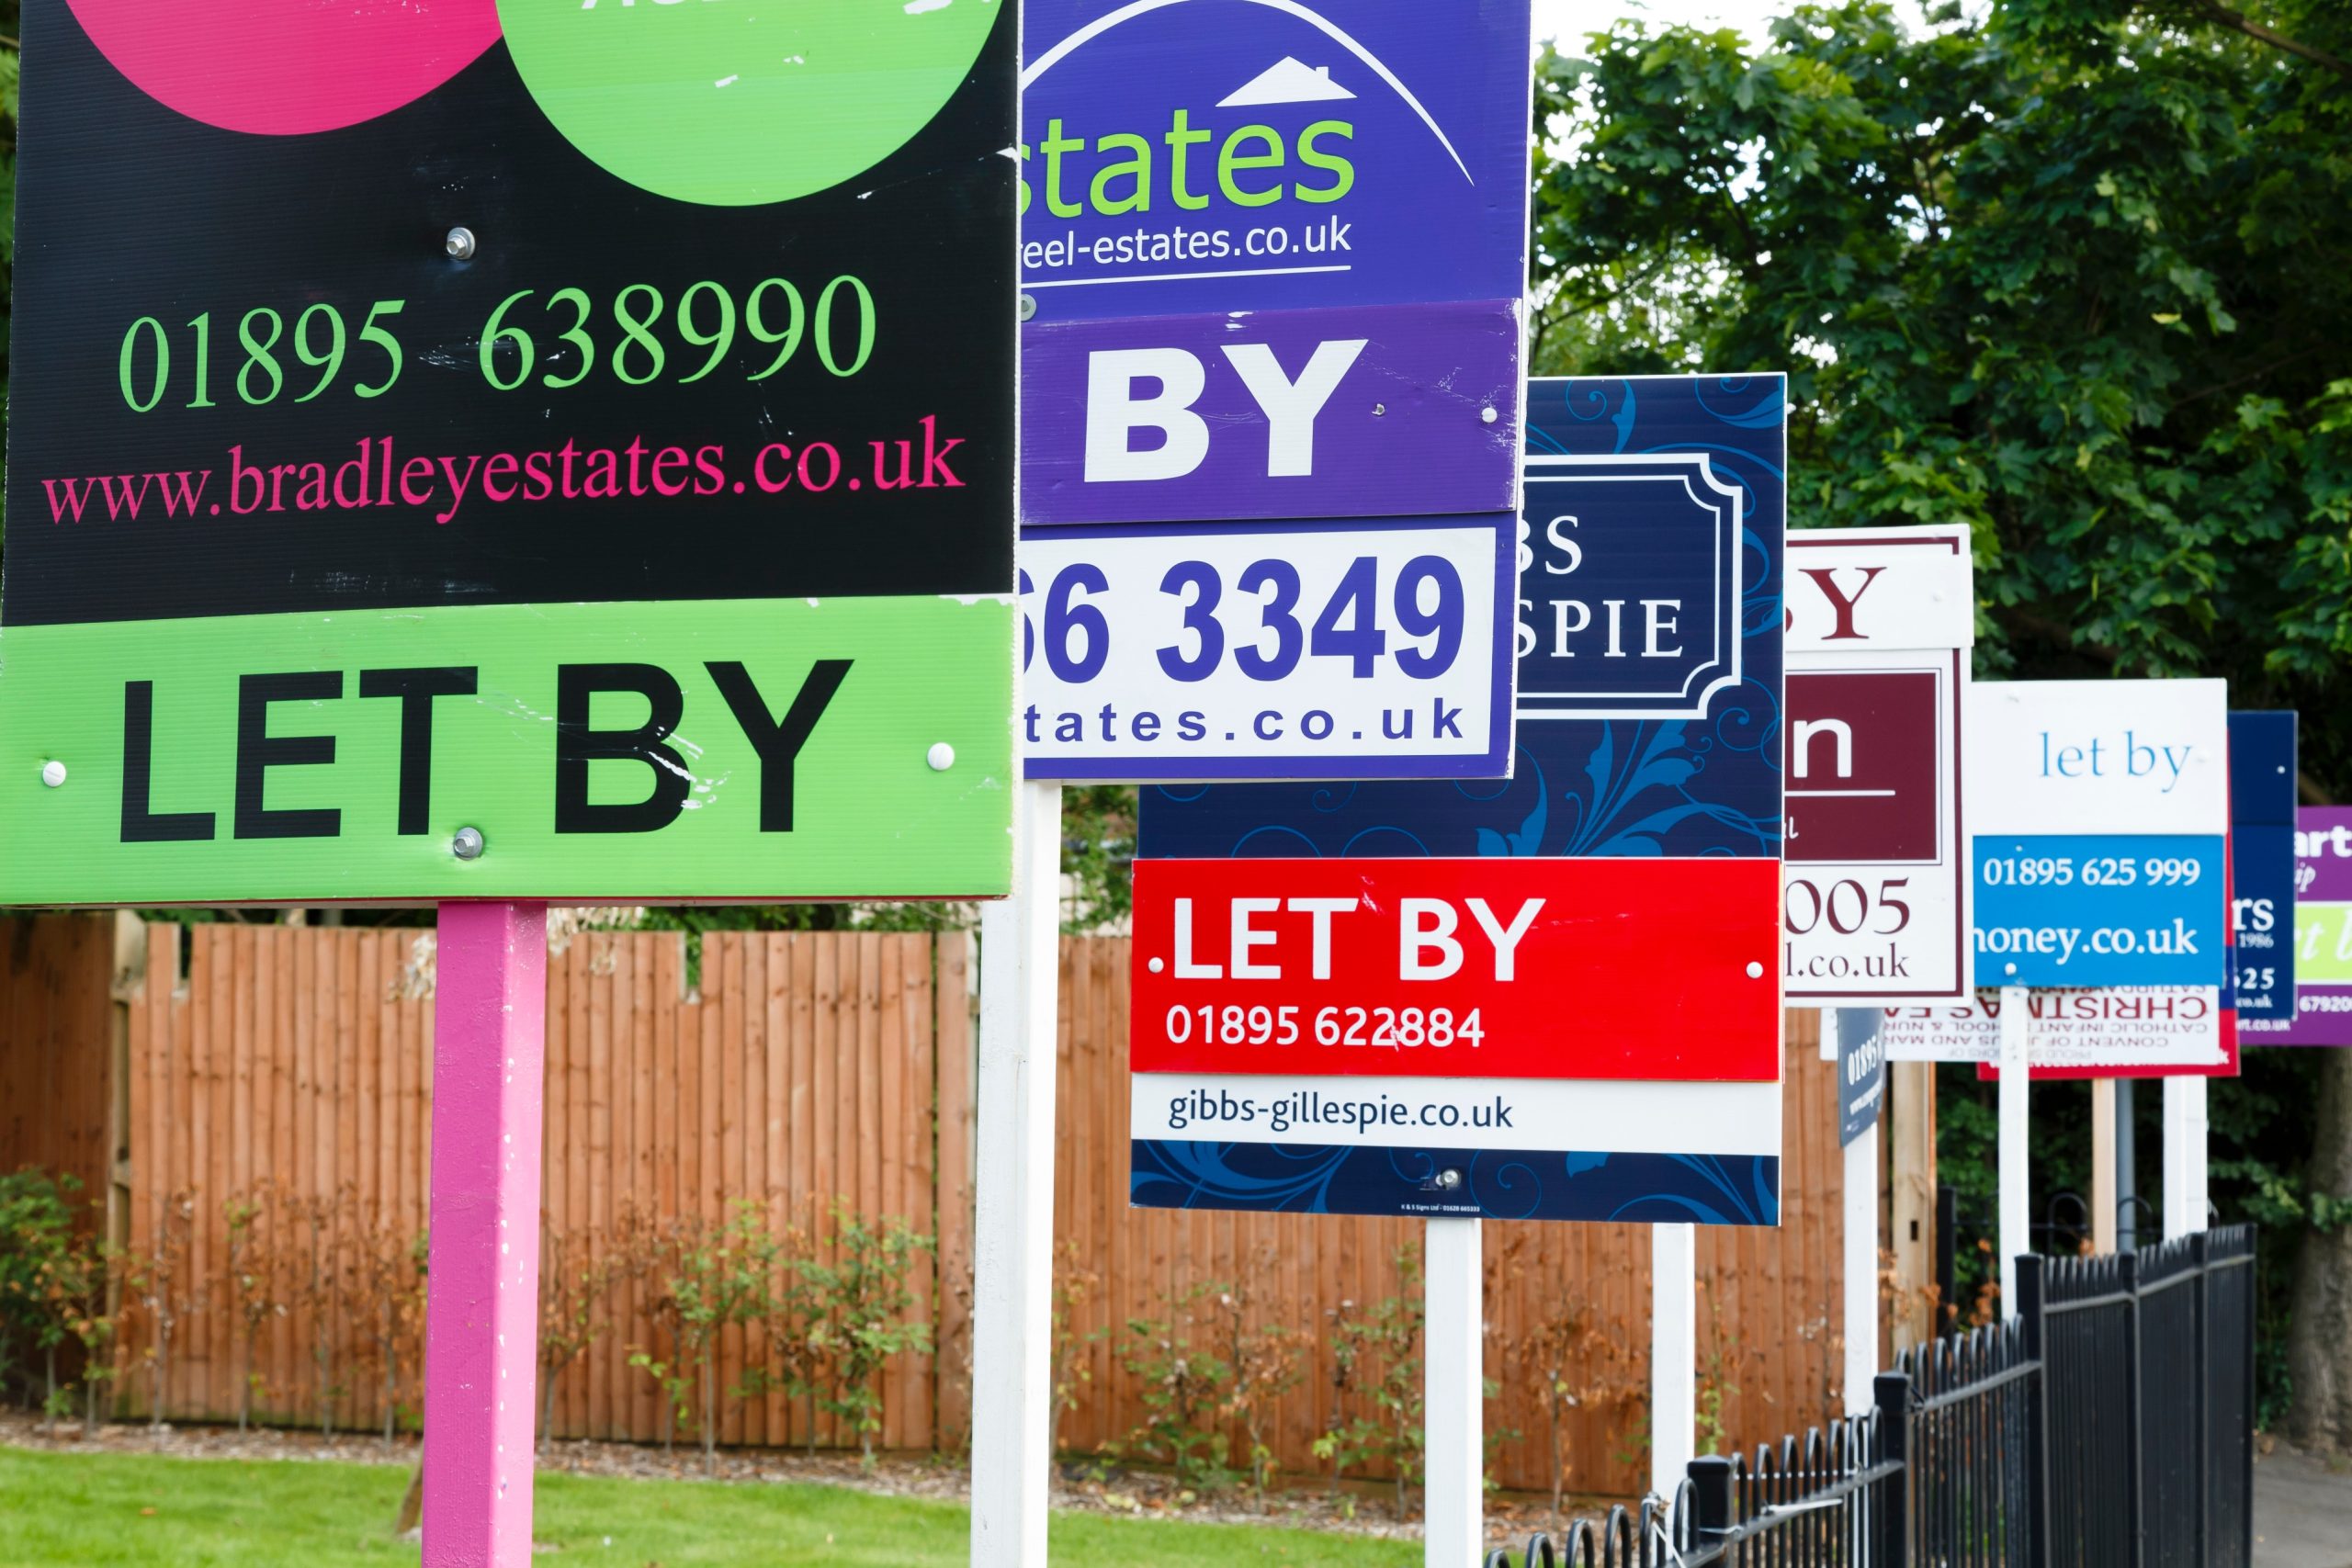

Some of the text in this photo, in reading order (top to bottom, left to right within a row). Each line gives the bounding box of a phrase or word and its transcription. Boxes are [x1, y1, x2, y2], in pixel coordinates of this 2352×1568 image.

[1022, 109, 1355, 219] tates
[1021, 215, 1351, 269] eel-estates.co.uk
[119, 275, 876, 412] 01895 638990
[1084, 339, 1369, 482] BY
[41, 414, 966, 525] www.bradleyestates.co.uk
[1019, 555, 1464, 683] 6 3349
[1785, 566, 1887, 640] Y
[1023, 697, 1464, 742] tates.co.uk
[120, 659, 854, 842] LET BY
[1793, 718, 1851, 778] n
[2040, 730, 2193, 793] let by
[1984, 858, 2200, 886] 01895 625 999
[1785, 876, 1910, 935] 005
[2232, 898, 2274, 931] rs
[1174, 897, 1546, 982] LET BY
[1785, 942, 1910, 978] l.co.uk
[2239, 933, 2274, 948] 1986
[1166, 1005, 1485, 1048] 01895 622884
[1932, 1035, 1973, 1045] AND
[2038, 1021, 2103, 1033] INFANT
[2045, 1036, 2070, 1046] OF
[2077, 1036, 2169, 1047] CONVENT
[2110, 1022, 2208, 1033] CATHOLIC
[1169, 1089, 1513, 1134] gibbs-gillespie.co.uk
